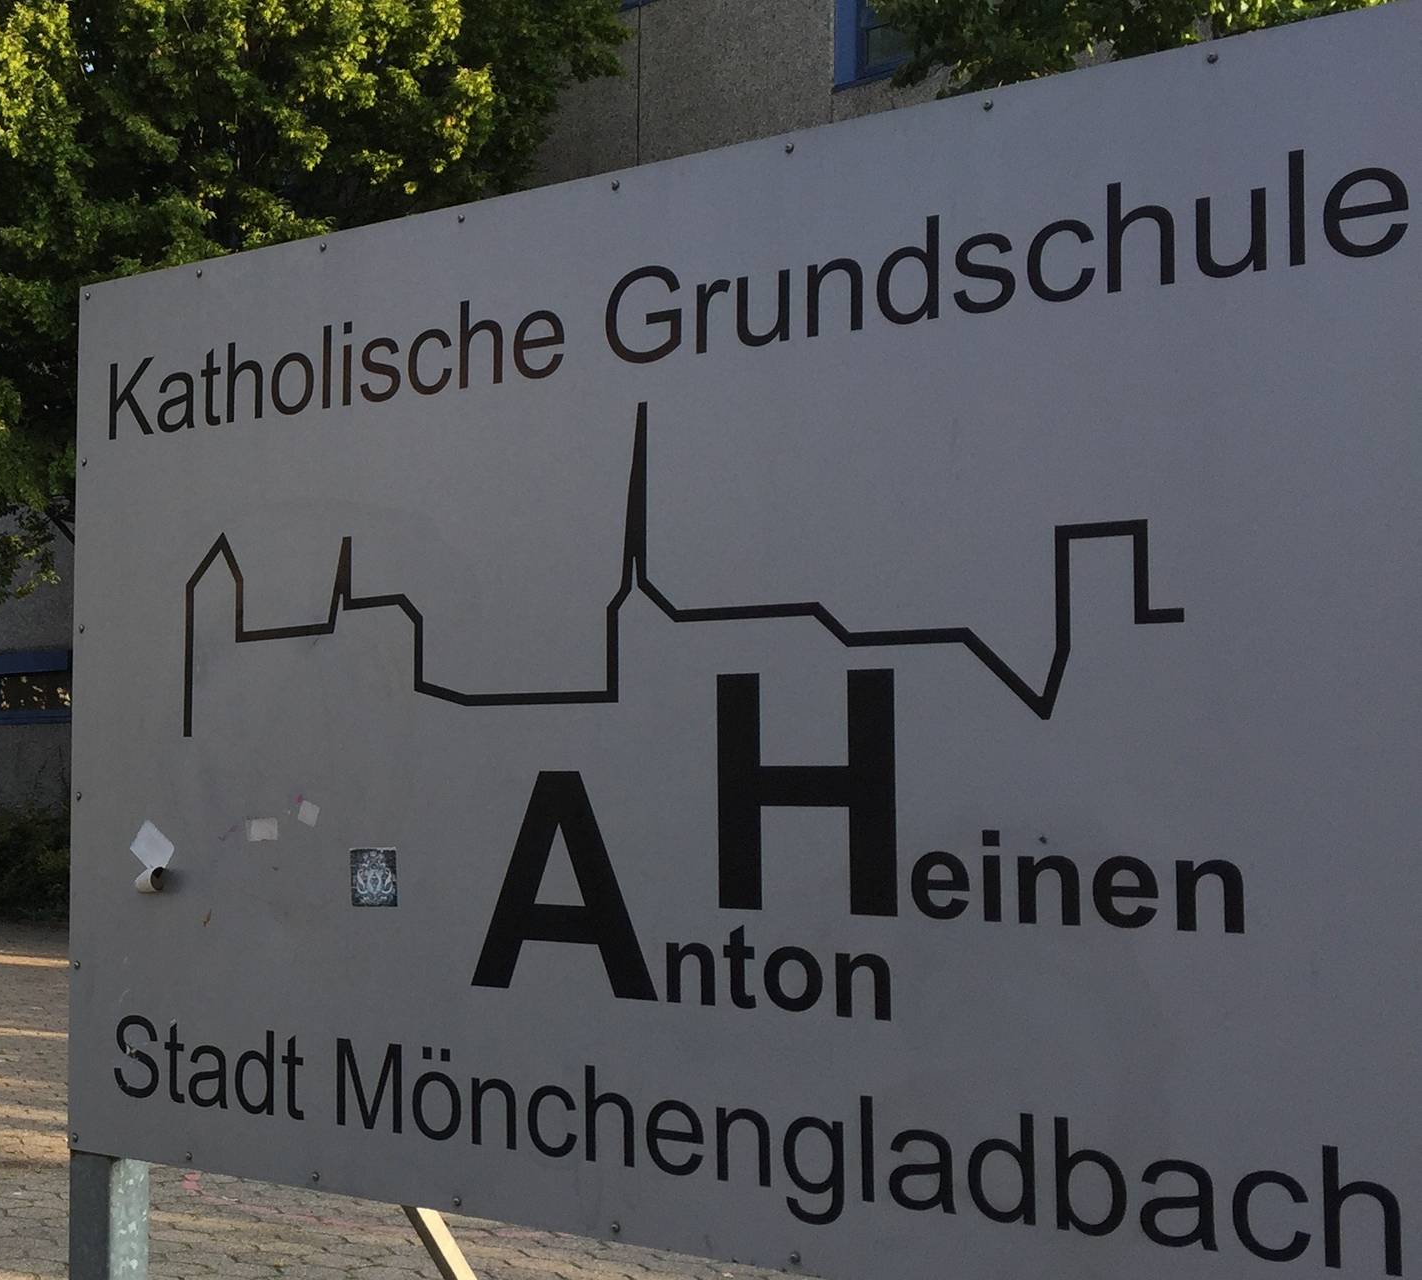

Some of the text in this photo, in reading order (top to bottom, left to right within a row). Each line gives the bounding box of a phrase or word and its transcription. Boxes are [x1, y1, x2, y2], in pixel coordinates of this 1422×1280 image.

[108, 148, 1410, 441] Katholische Grundschule
[469, 770, 892, 1023] Anton
[716, 667, 1246, 935] Heinen
[113, 1014, 1403, 1278] Stadt Mönchengladbach
